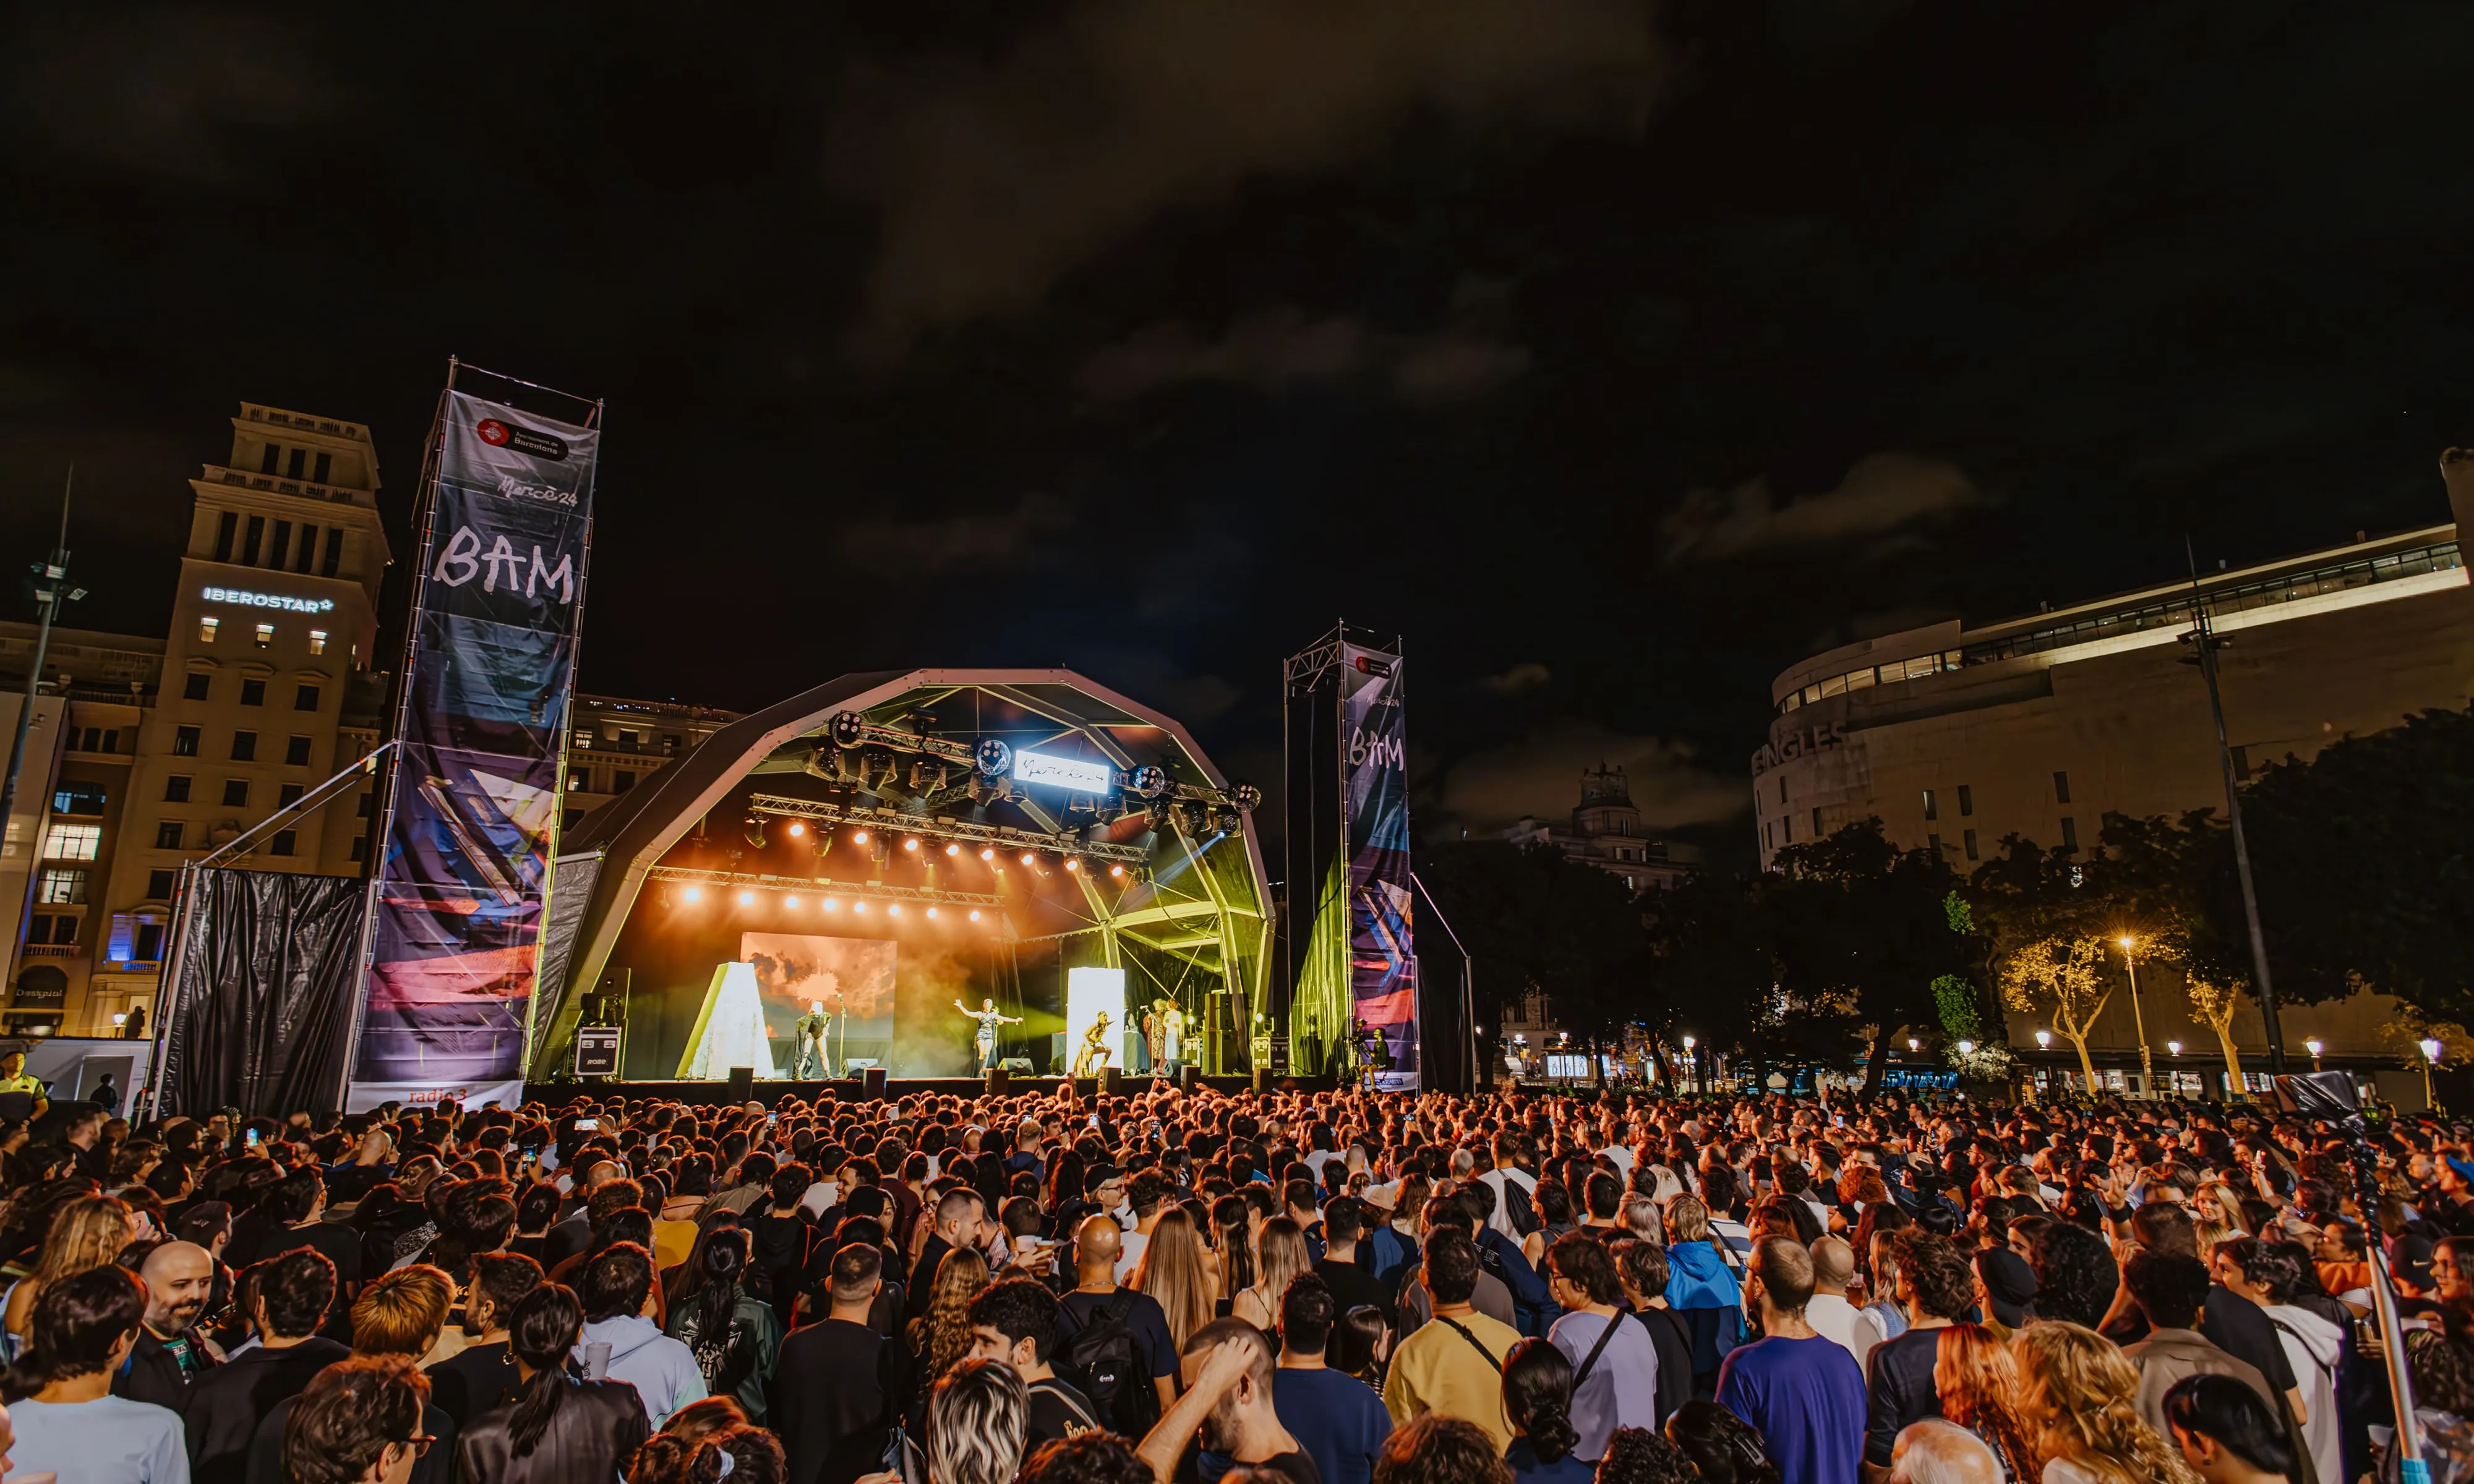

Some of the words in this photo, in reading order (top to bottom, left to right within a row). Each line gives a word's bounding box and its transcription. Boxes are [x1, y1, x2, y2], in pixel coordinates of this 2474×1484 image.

[515, 437, 558, 454] Barcelona
[433, 526, 574, 604] BAM
[203, 587, 320, 613] IBEROSTAR
[1349, 726, 1405, 772] BAM
[409, 1088, 454, 1103] radio
[458, 1088, 467, 1101] 3
